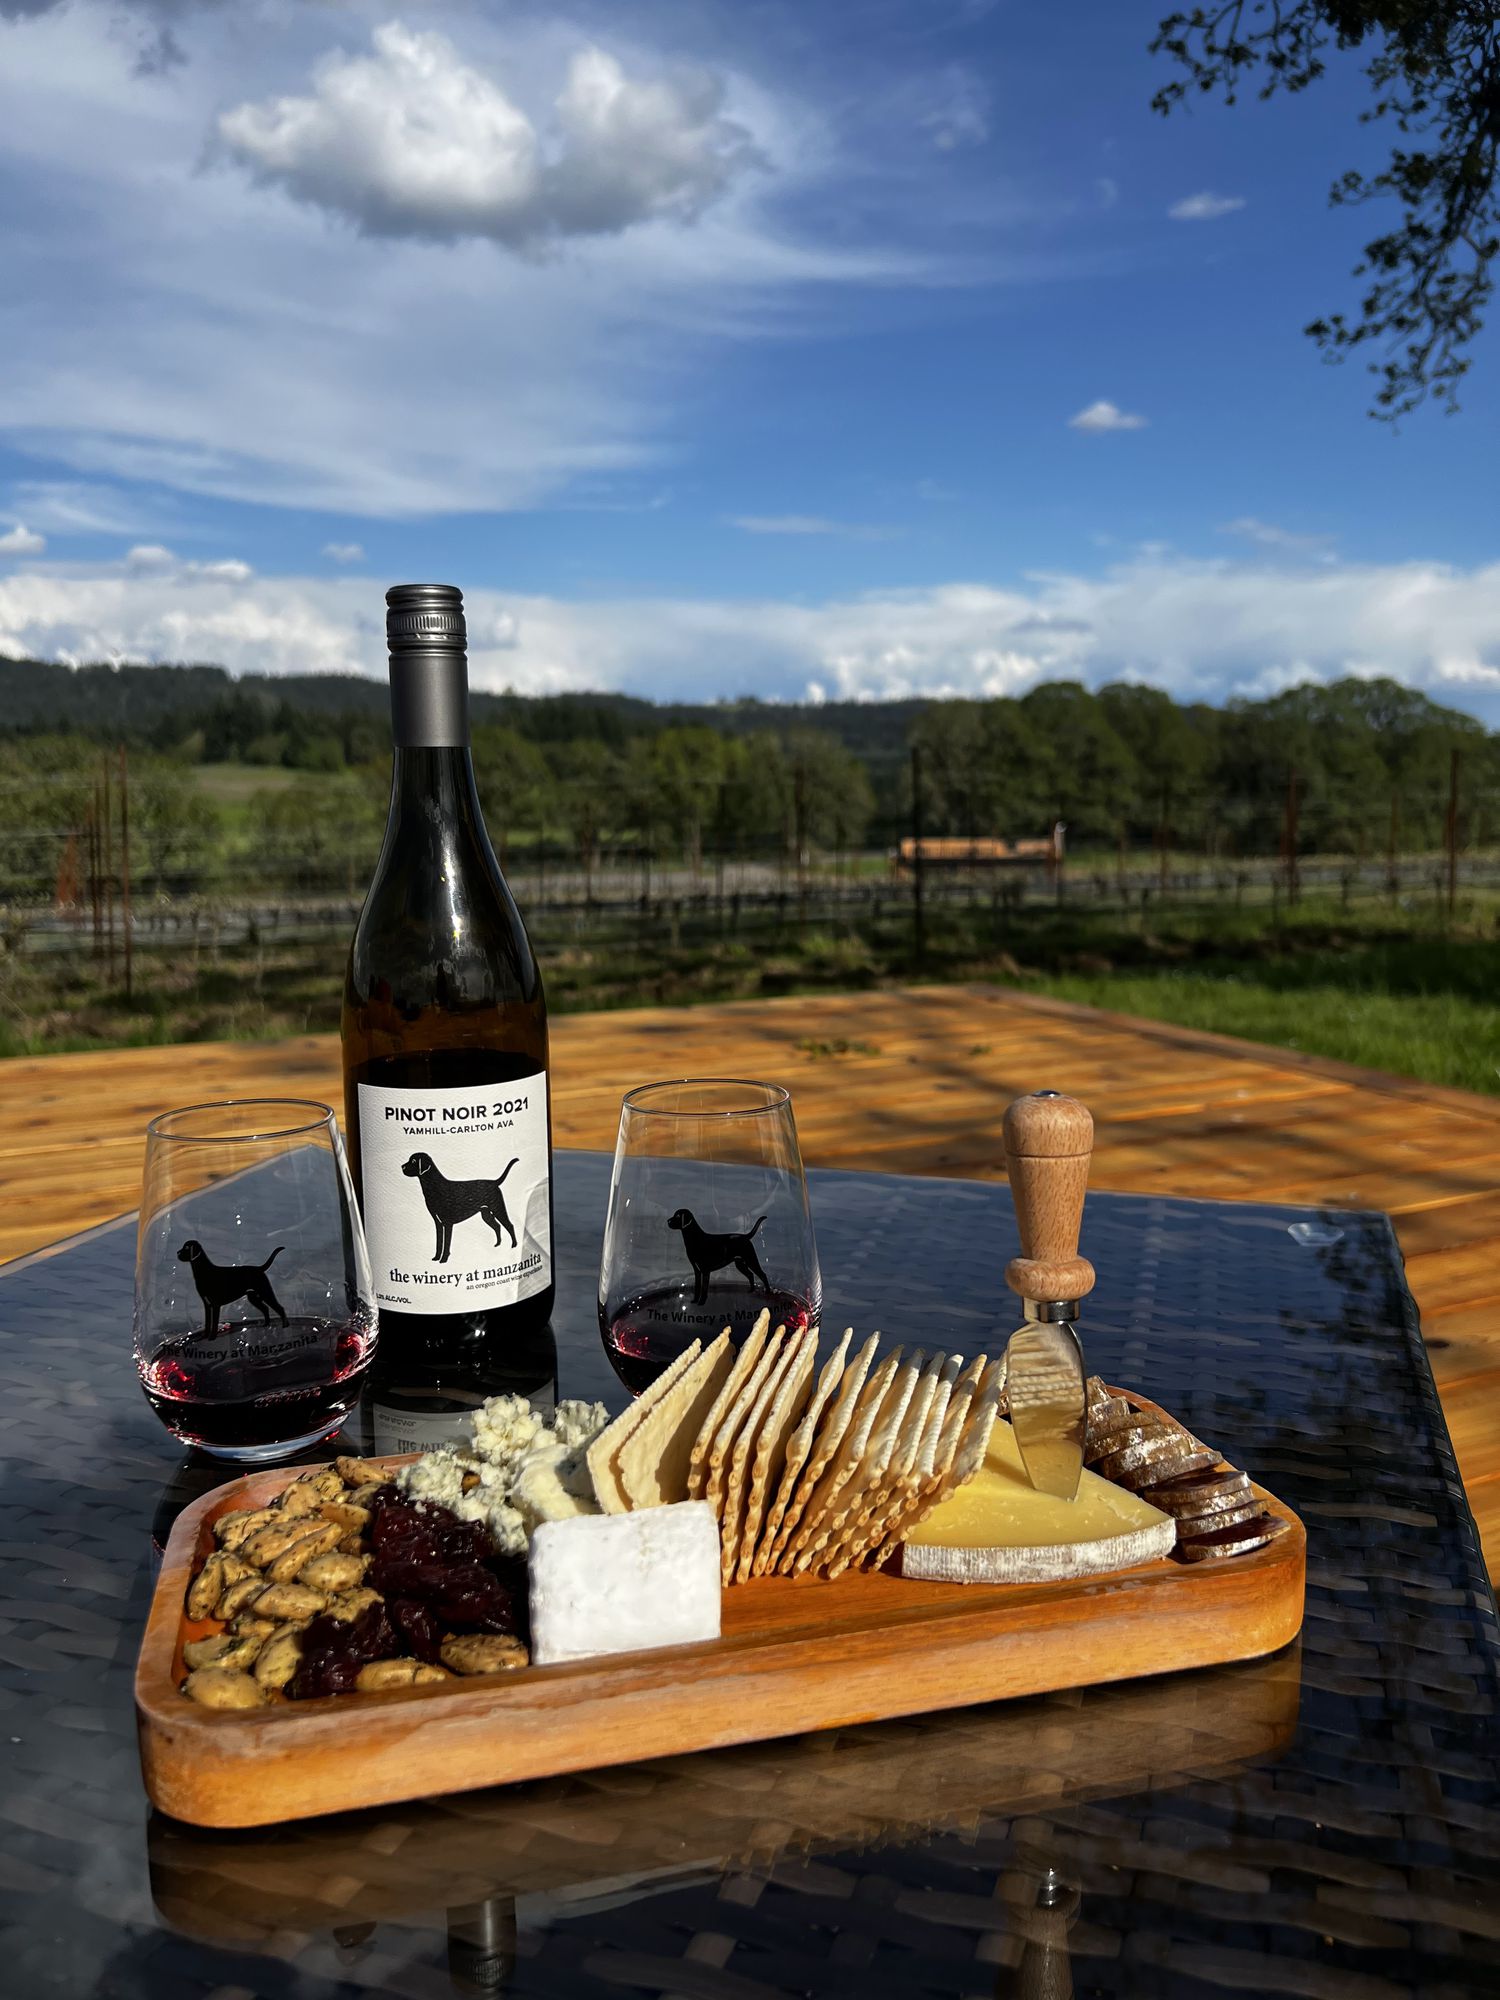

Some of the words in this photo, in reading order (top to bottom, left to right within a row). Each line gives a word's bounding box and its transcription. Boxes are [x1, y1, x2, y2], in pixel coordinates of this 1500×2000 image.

[385, 1106, 436, 1122] PINOT
[442, 1105, 487, 1121] NOIR
[493, 1096, 529, 1116] 2021
[403, 1122, 494, 1135] YAMHILL-CARLTON
[497, 1119, 514, 1129] AVA
[390, 1268, 410, 1283] the
[412, 1271, 463, 1287] winery
[466, 1269, 480, 1283] at
[483, 1253, 542, 1280] manzanita
[475, 1281, 495, 1289] oregon
[648, 1309, 668, 1322] The
[672, 1311, 716, 1326] Winery
[719, 1313, 732, 1323] at
[735, 1302, 793, 1321] Mannita
[183, 1347, 226, 1360] Winery
[231, 1349, 244, 1358] at
[248, 1334, 318, 1357] Manzanita
